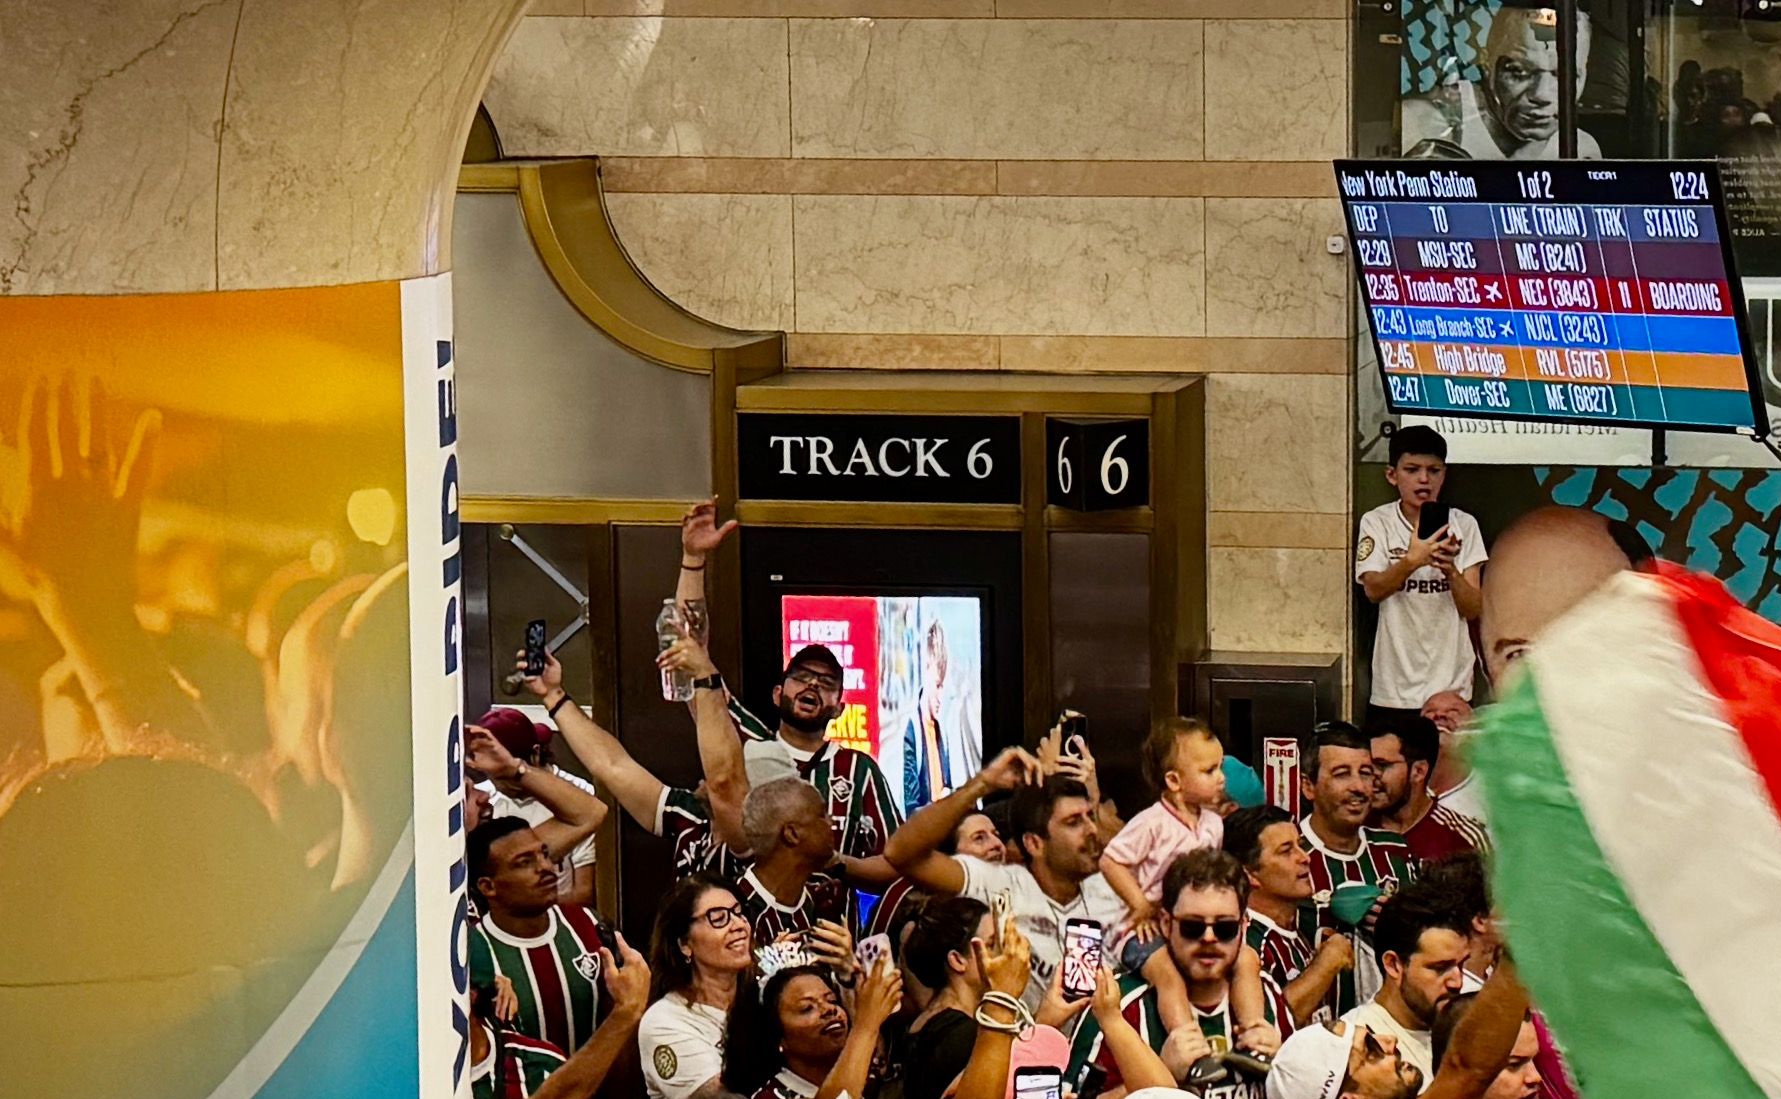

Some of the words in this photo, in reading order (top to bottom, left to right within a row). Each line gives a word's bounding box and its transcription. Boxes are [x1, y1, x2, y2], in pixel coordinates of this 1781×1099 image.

[1365, 170, 1398, 197] York
[1396, 170, 1431, 197] Penn
[1430, 170, 1478, 198] Station
[1517, 171, 1527, 199] 1
[1526, 171, 1541, 199] of
[1541, 171, 1555, 199] 2
[1670, 171, 1709, 200] 12:24
[1353, 205, 1378, 232] DEP
[1428, 206, 1449, 234] TO
[1499, 207, 1532, 235] LINE
[1532, 207, 1587, 237] (TRAIN)
[1594, 208, 1626, 237] TRK
[1643, 208, 1699, 238] STATUS
[1417, 241, 1477, 269] MSU-SEC
[1514, 243, 1540, 271] MC
[1365, 274, 1399, 300] 12:35
[1403, 275, 1481, 303] Trenton-SEC
[1518, 278, 1547, 306] NEC
[1547, 278, 1598, 310] (3843)
[1618, 281, 1632, 308] 11
[1649, 282, 1722, 311] BOARDING
[1372, 308, 1407, 335] 12:43
[1408, 314, 1437, 340] Long
[1435, 315, 1496, 340] Branch-SEC
[1523, 313, 1558, 342] NJCL
[1557, 313, 1608, 345] (3243)
[1380, 341, 1415, 369] 12:45
[1432, 344, 1465, 375] High
[1462, 345, 1508, 378] Bridge
[1535, 348, 1565, 377] RVL
[1564, 348, 1612, 380] (5175)
[1387, 375, 1420, 402] 12:47
[1444, 378, 1511, 408] Dover-SEC
[1544, 383, 1568, 412] ME
[769, 435, 950, 478] TRACK
[966, 437, 994, 479] 6
[1057, 436, 1073, 494] 6
[1100, 434, 1129, 494] 6
[1269, 748, 1294, 758] FIRE
